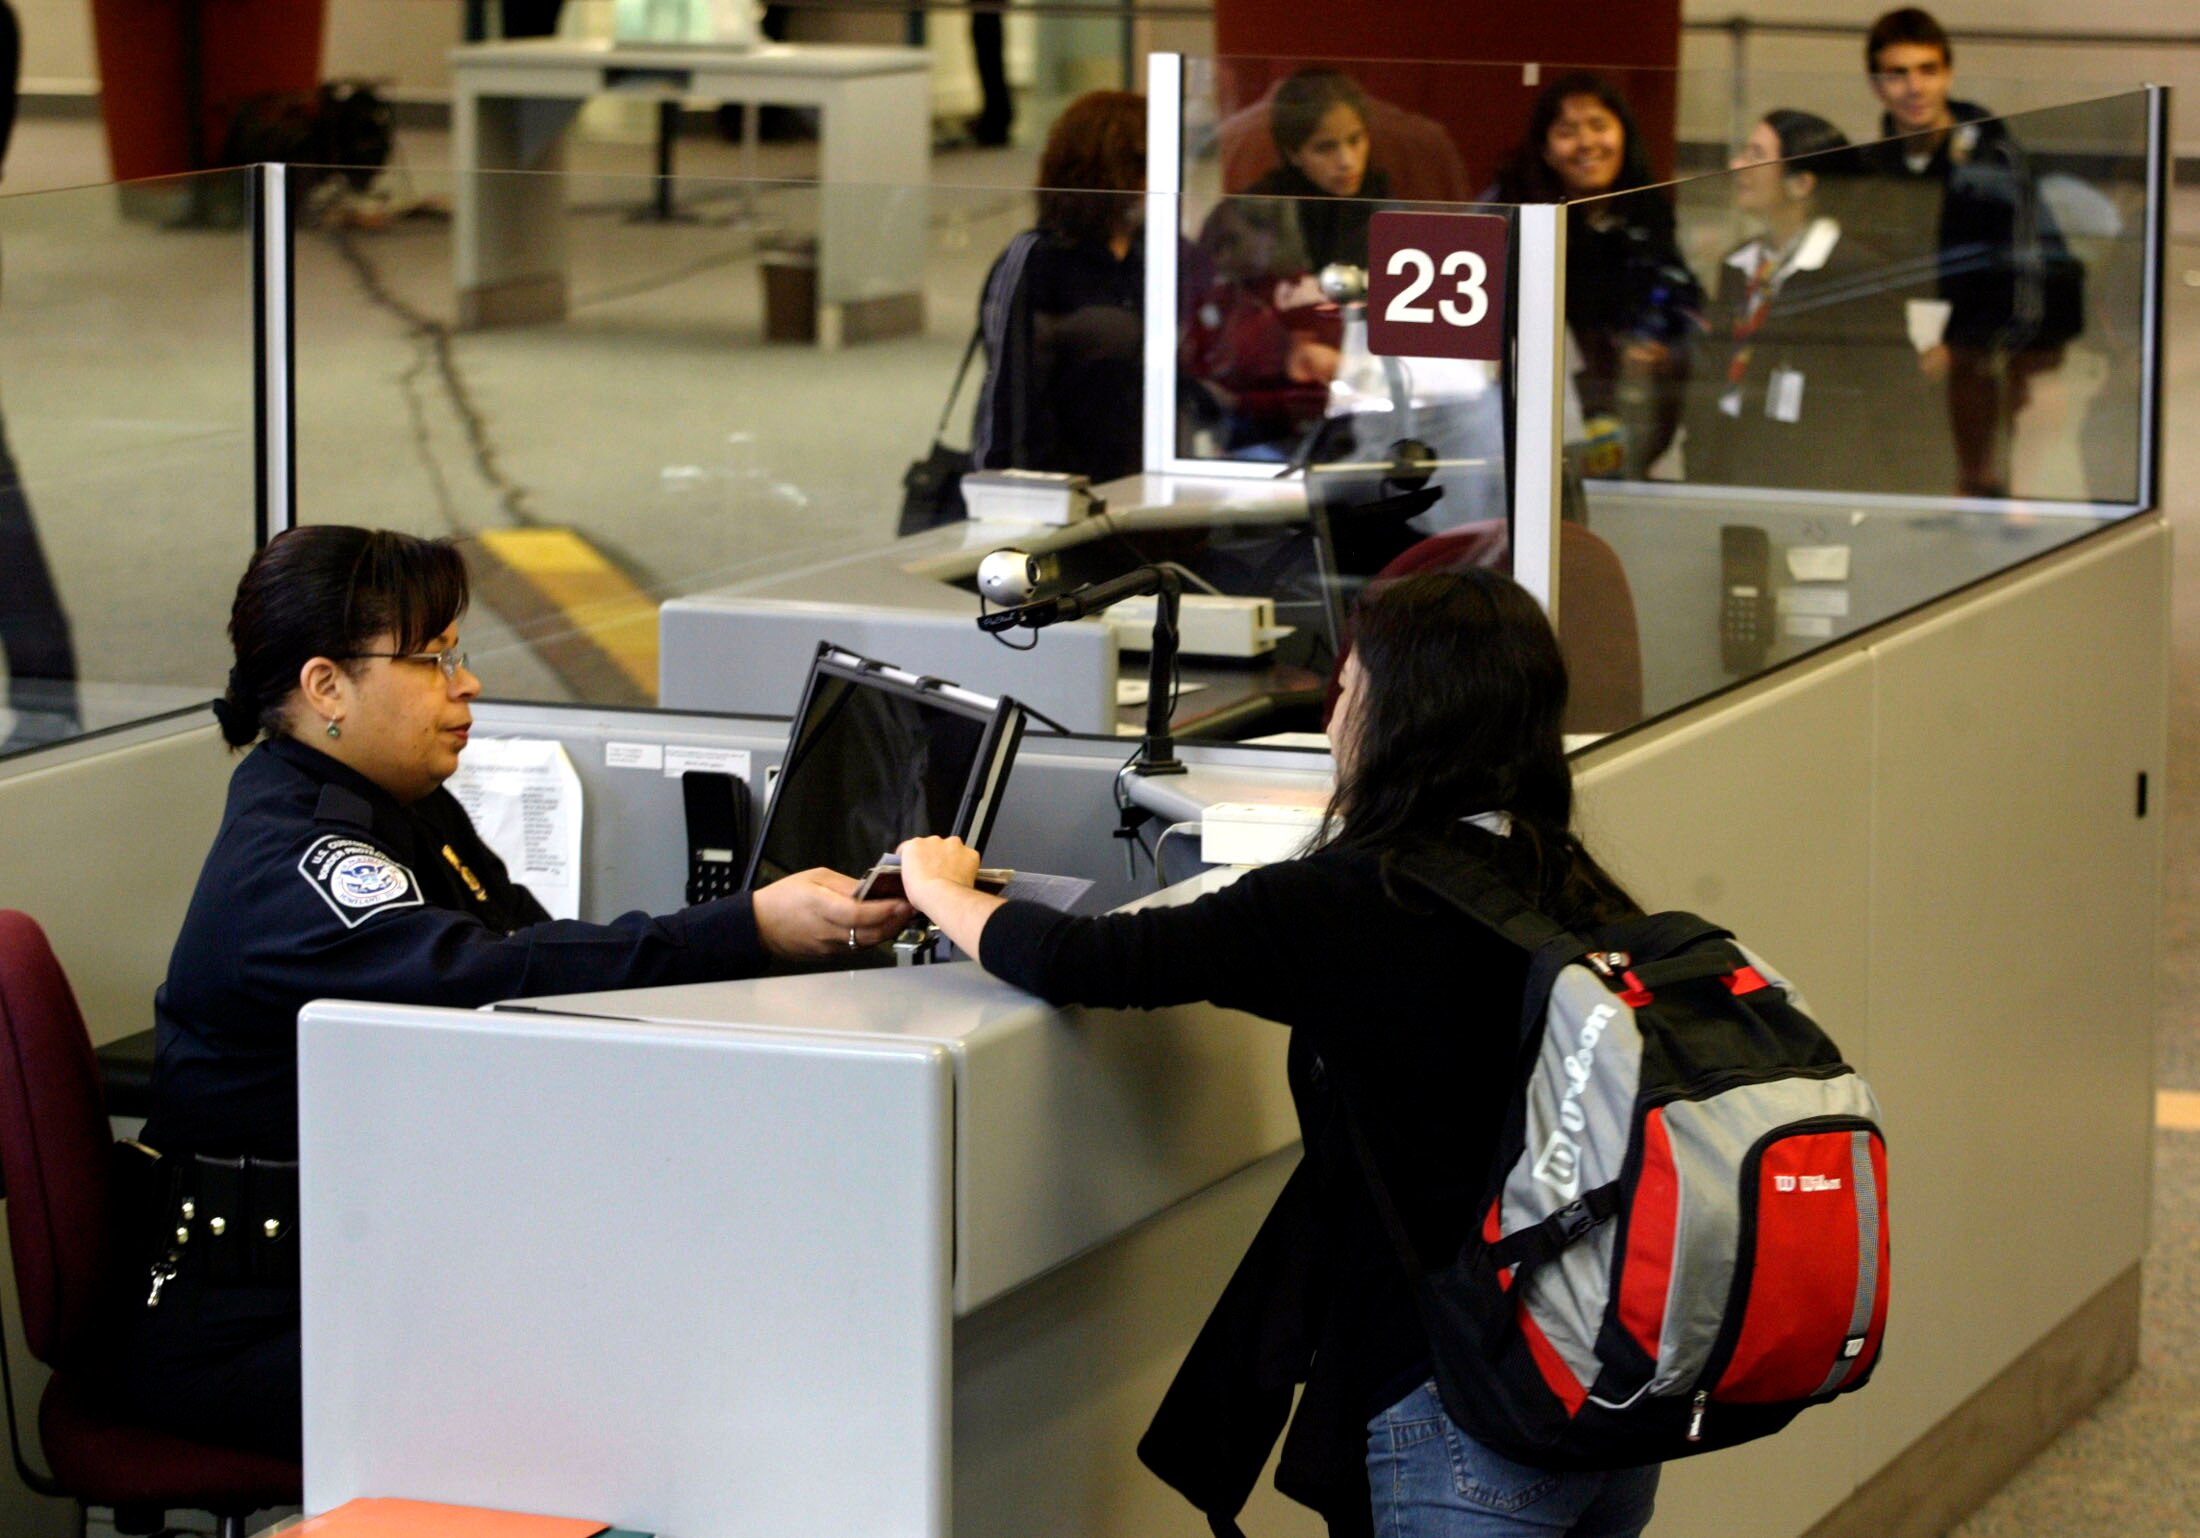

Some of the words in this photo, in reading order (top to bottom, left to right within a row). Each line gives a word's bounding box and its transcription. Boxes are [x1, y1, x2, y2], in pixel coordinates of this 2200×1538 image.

[1384, 248, 1489, 327] 23
[317, 850, 346, 881] BORDER
[1560, 1003, 1618, 1132] Wilson
